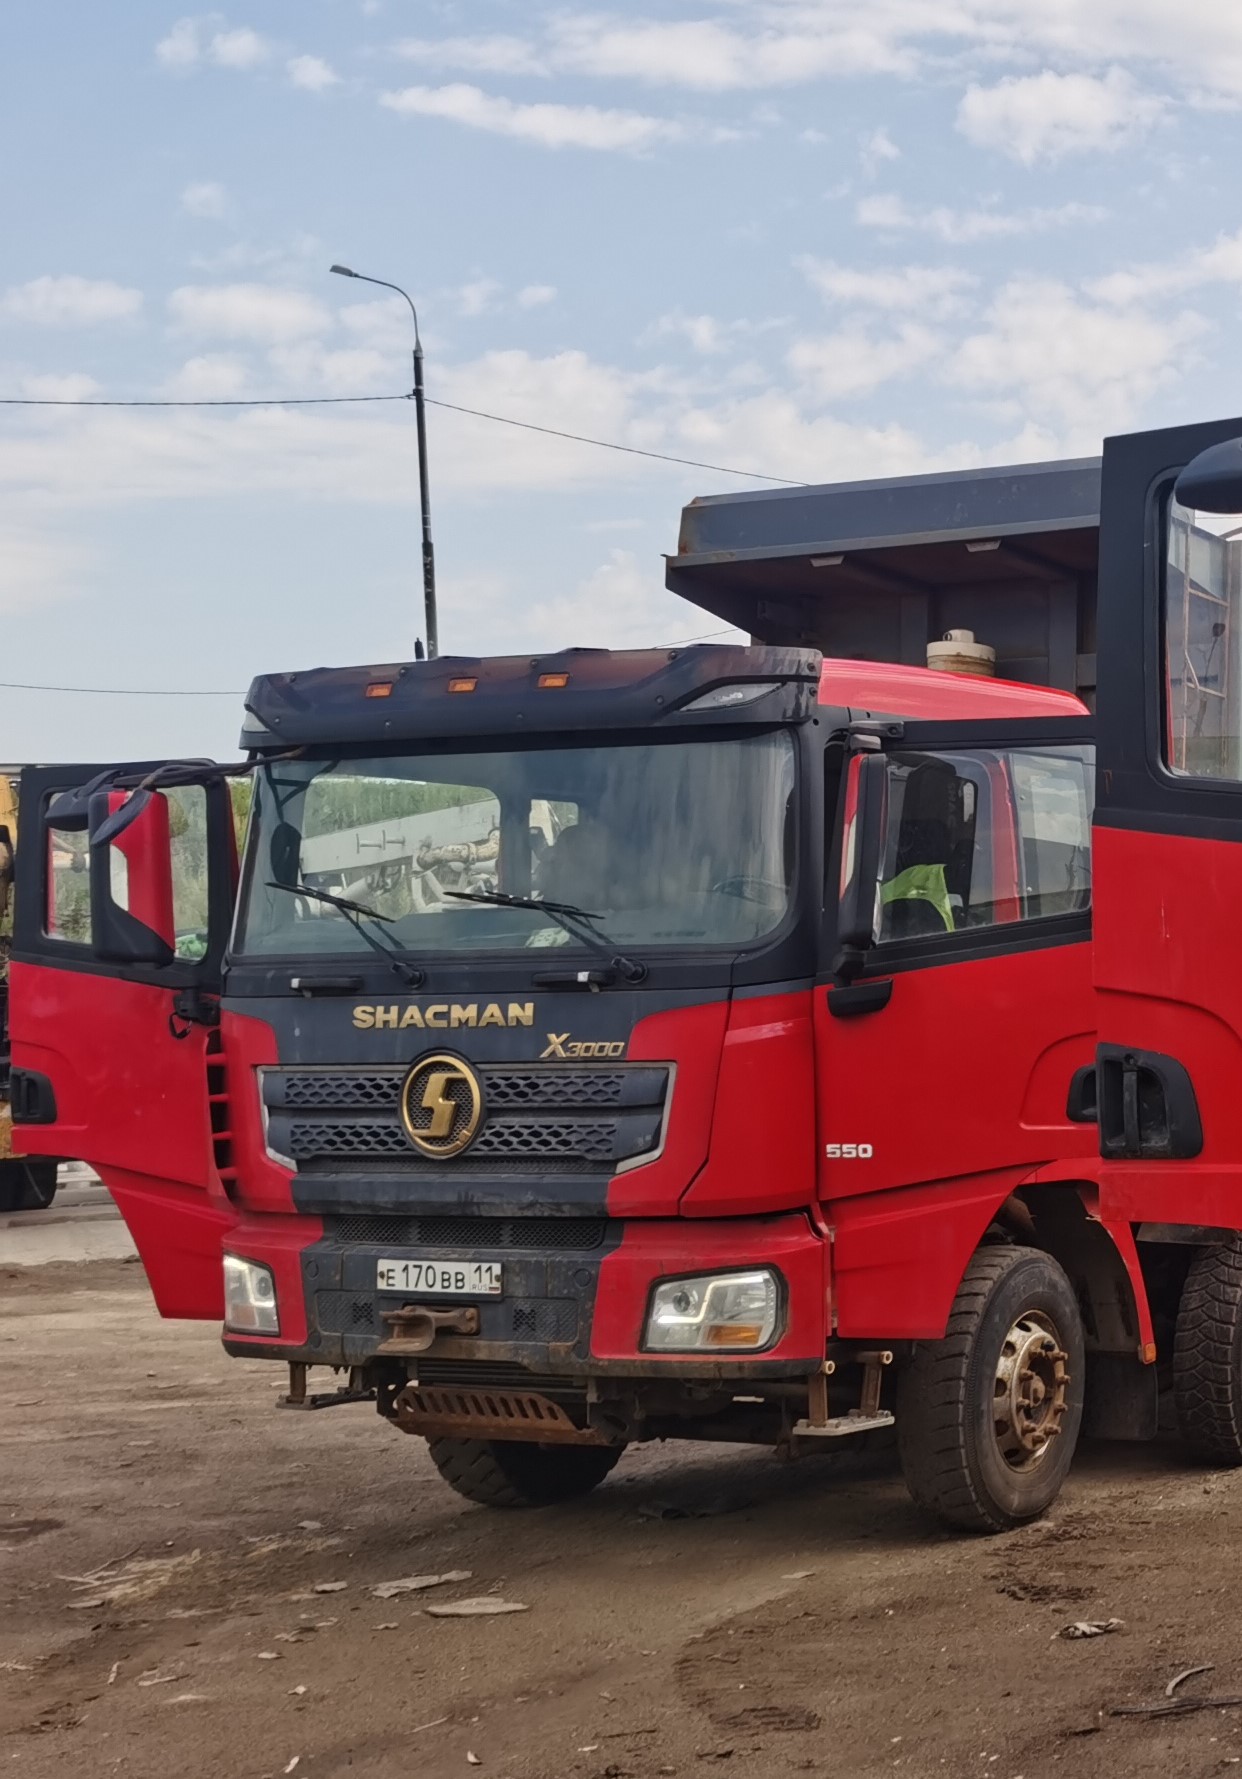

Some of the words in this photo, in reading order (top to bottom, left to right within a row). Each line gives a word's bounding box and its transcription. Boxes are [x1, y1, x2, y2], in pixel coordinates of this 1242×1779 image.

[352, 1002, 535, 1029] SHACMAN
[540, 1033, 625, 1058] X3000
[826, 1143, 873, 1158] 550
[473, 1264, 493, 1285] 11
